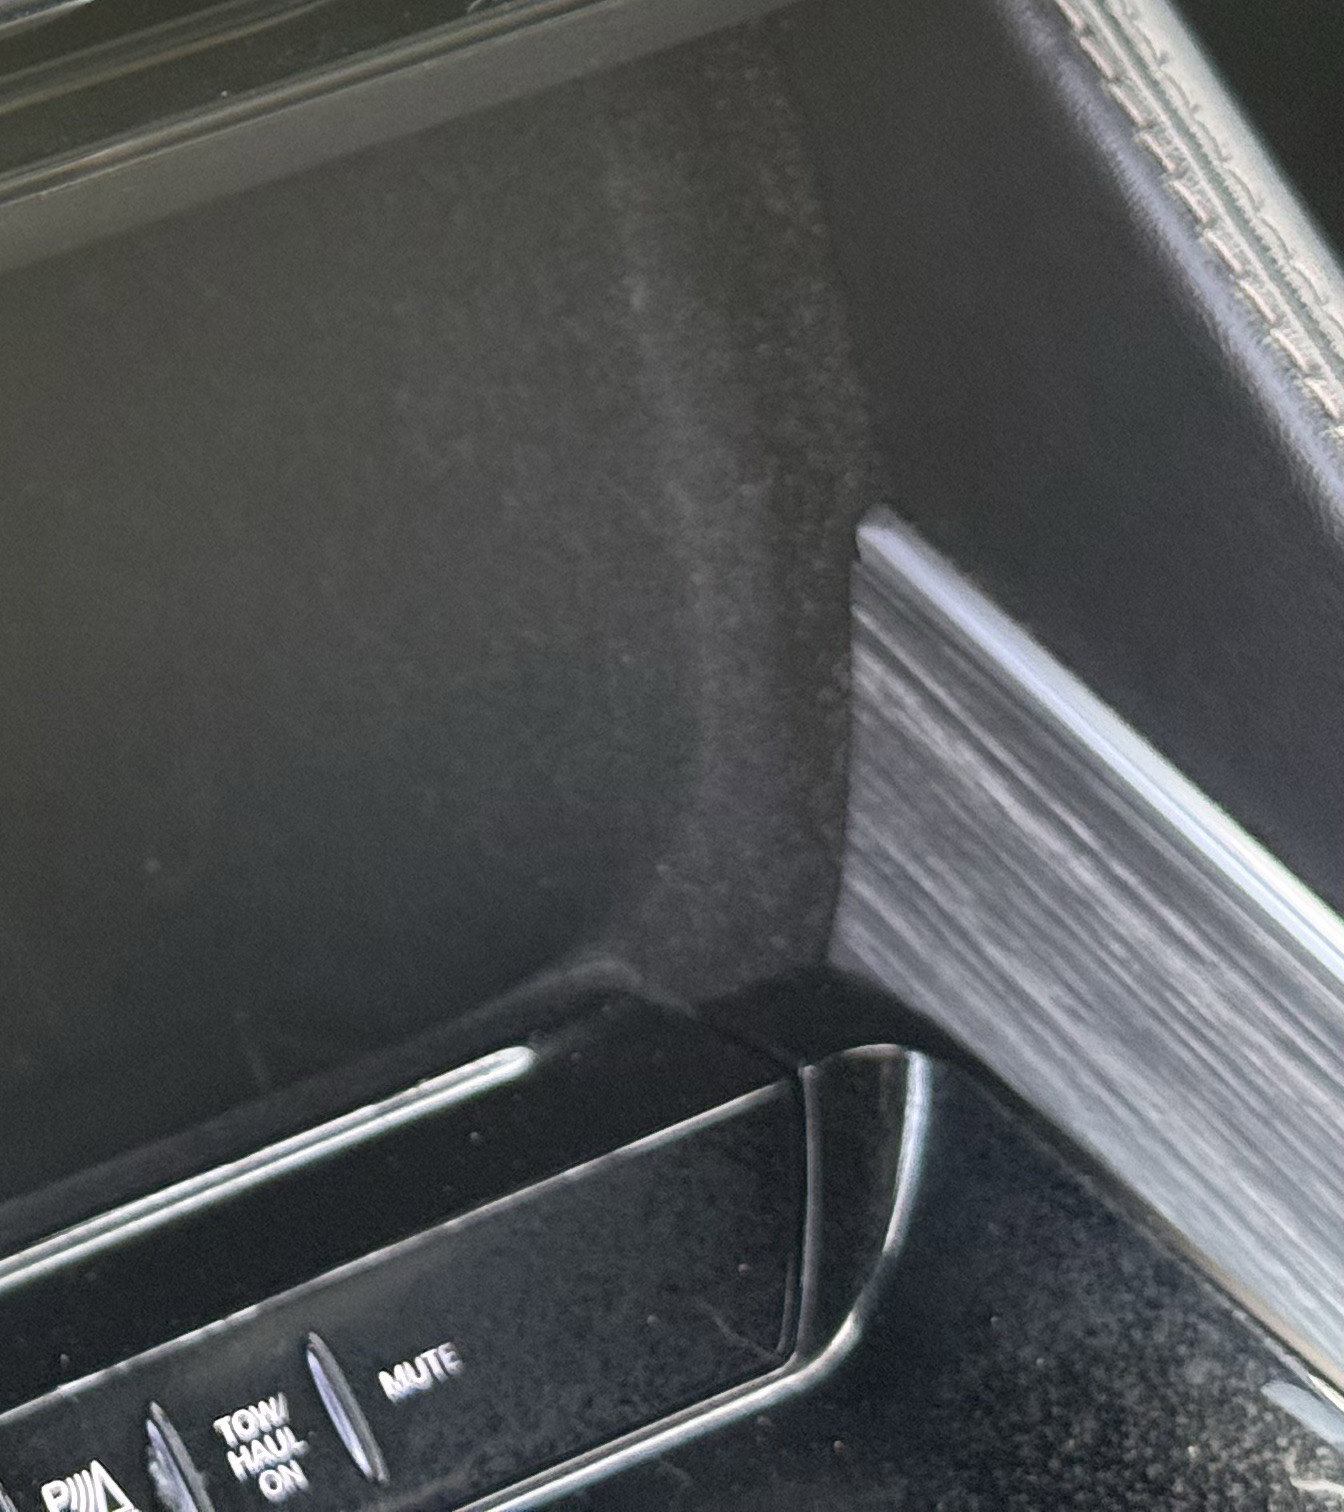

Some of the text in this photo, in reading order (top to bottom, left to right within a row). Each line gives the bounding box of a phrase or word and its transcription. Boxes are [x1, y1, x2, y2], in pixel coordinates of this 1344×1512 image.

[378, 1341, 464, 1404] MUTE
[226, 1425, 310, 1483] HAUL
[258, 1458, 310, 1503] ON
